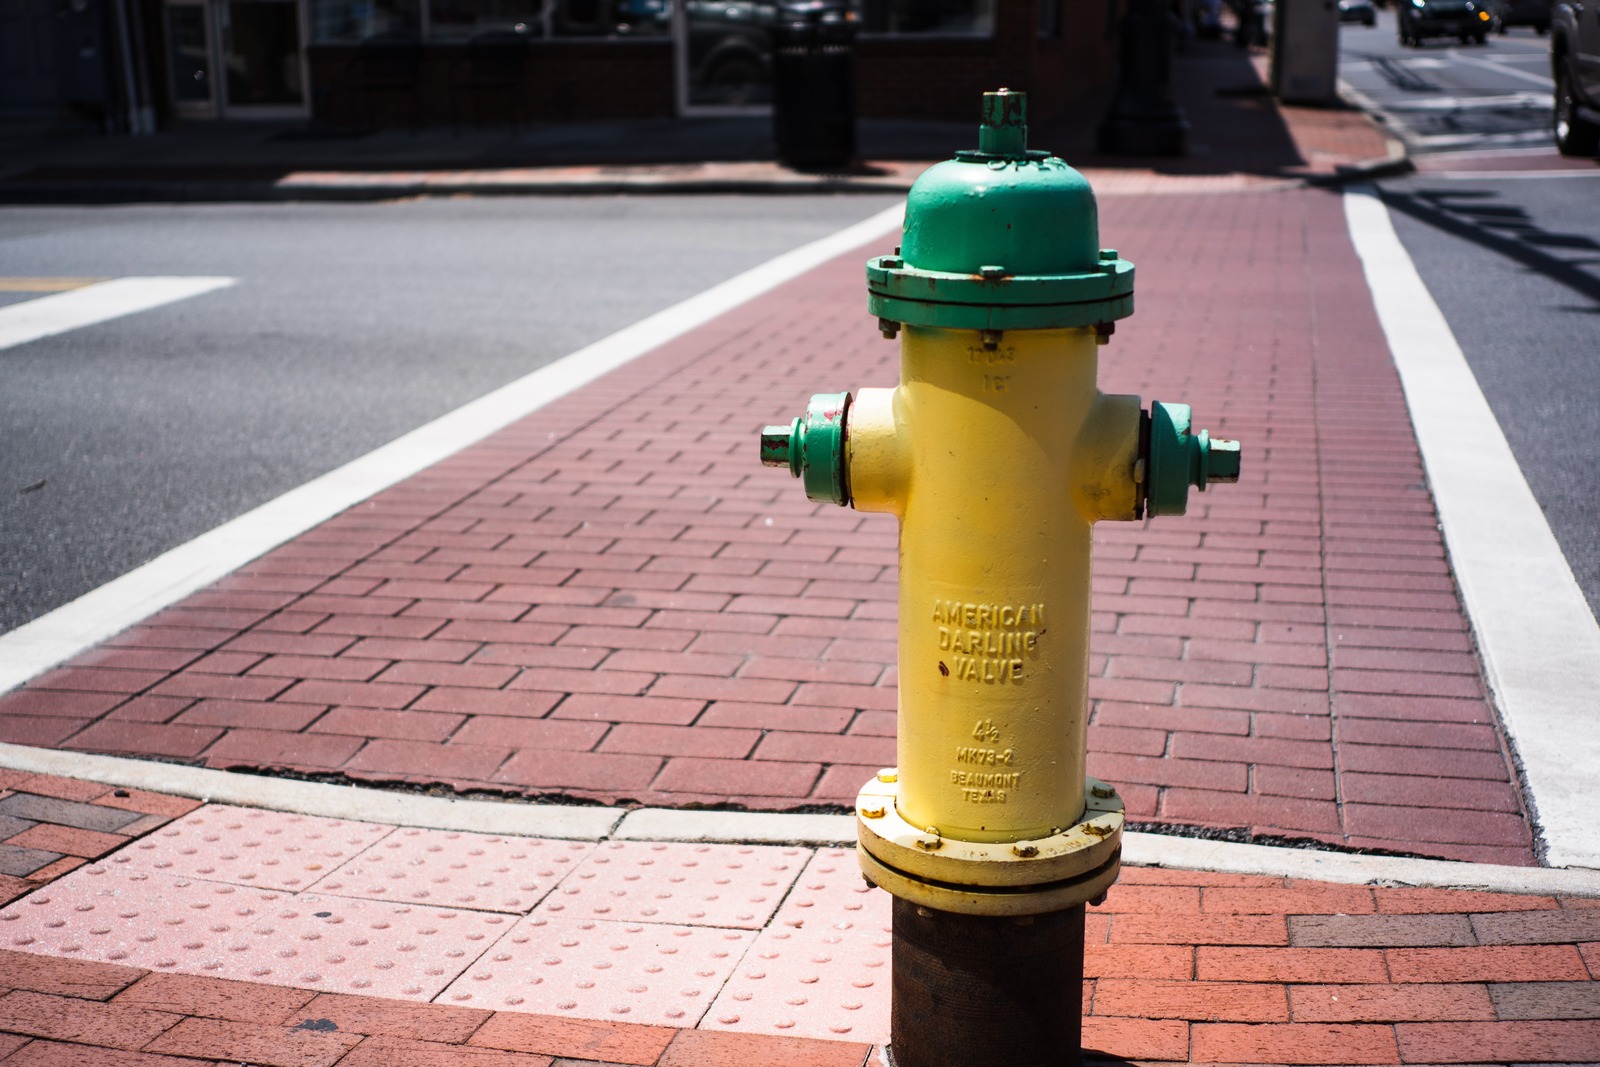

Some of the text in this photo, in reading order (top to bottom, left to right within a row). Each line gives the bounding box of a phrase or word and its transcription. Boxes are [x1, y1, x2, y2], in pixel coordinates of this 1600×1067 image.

[931, 599, 1045, 627] AMERICAN
[938, 626, 1037, 655] DARLING
[953, 655, 1023, 682] VALVE
[956, 746, 1013, 766] MK73-2
[950, 769, 1021, 789] BEAUMONT
[961, 787, 1007, 804] TEXAS
